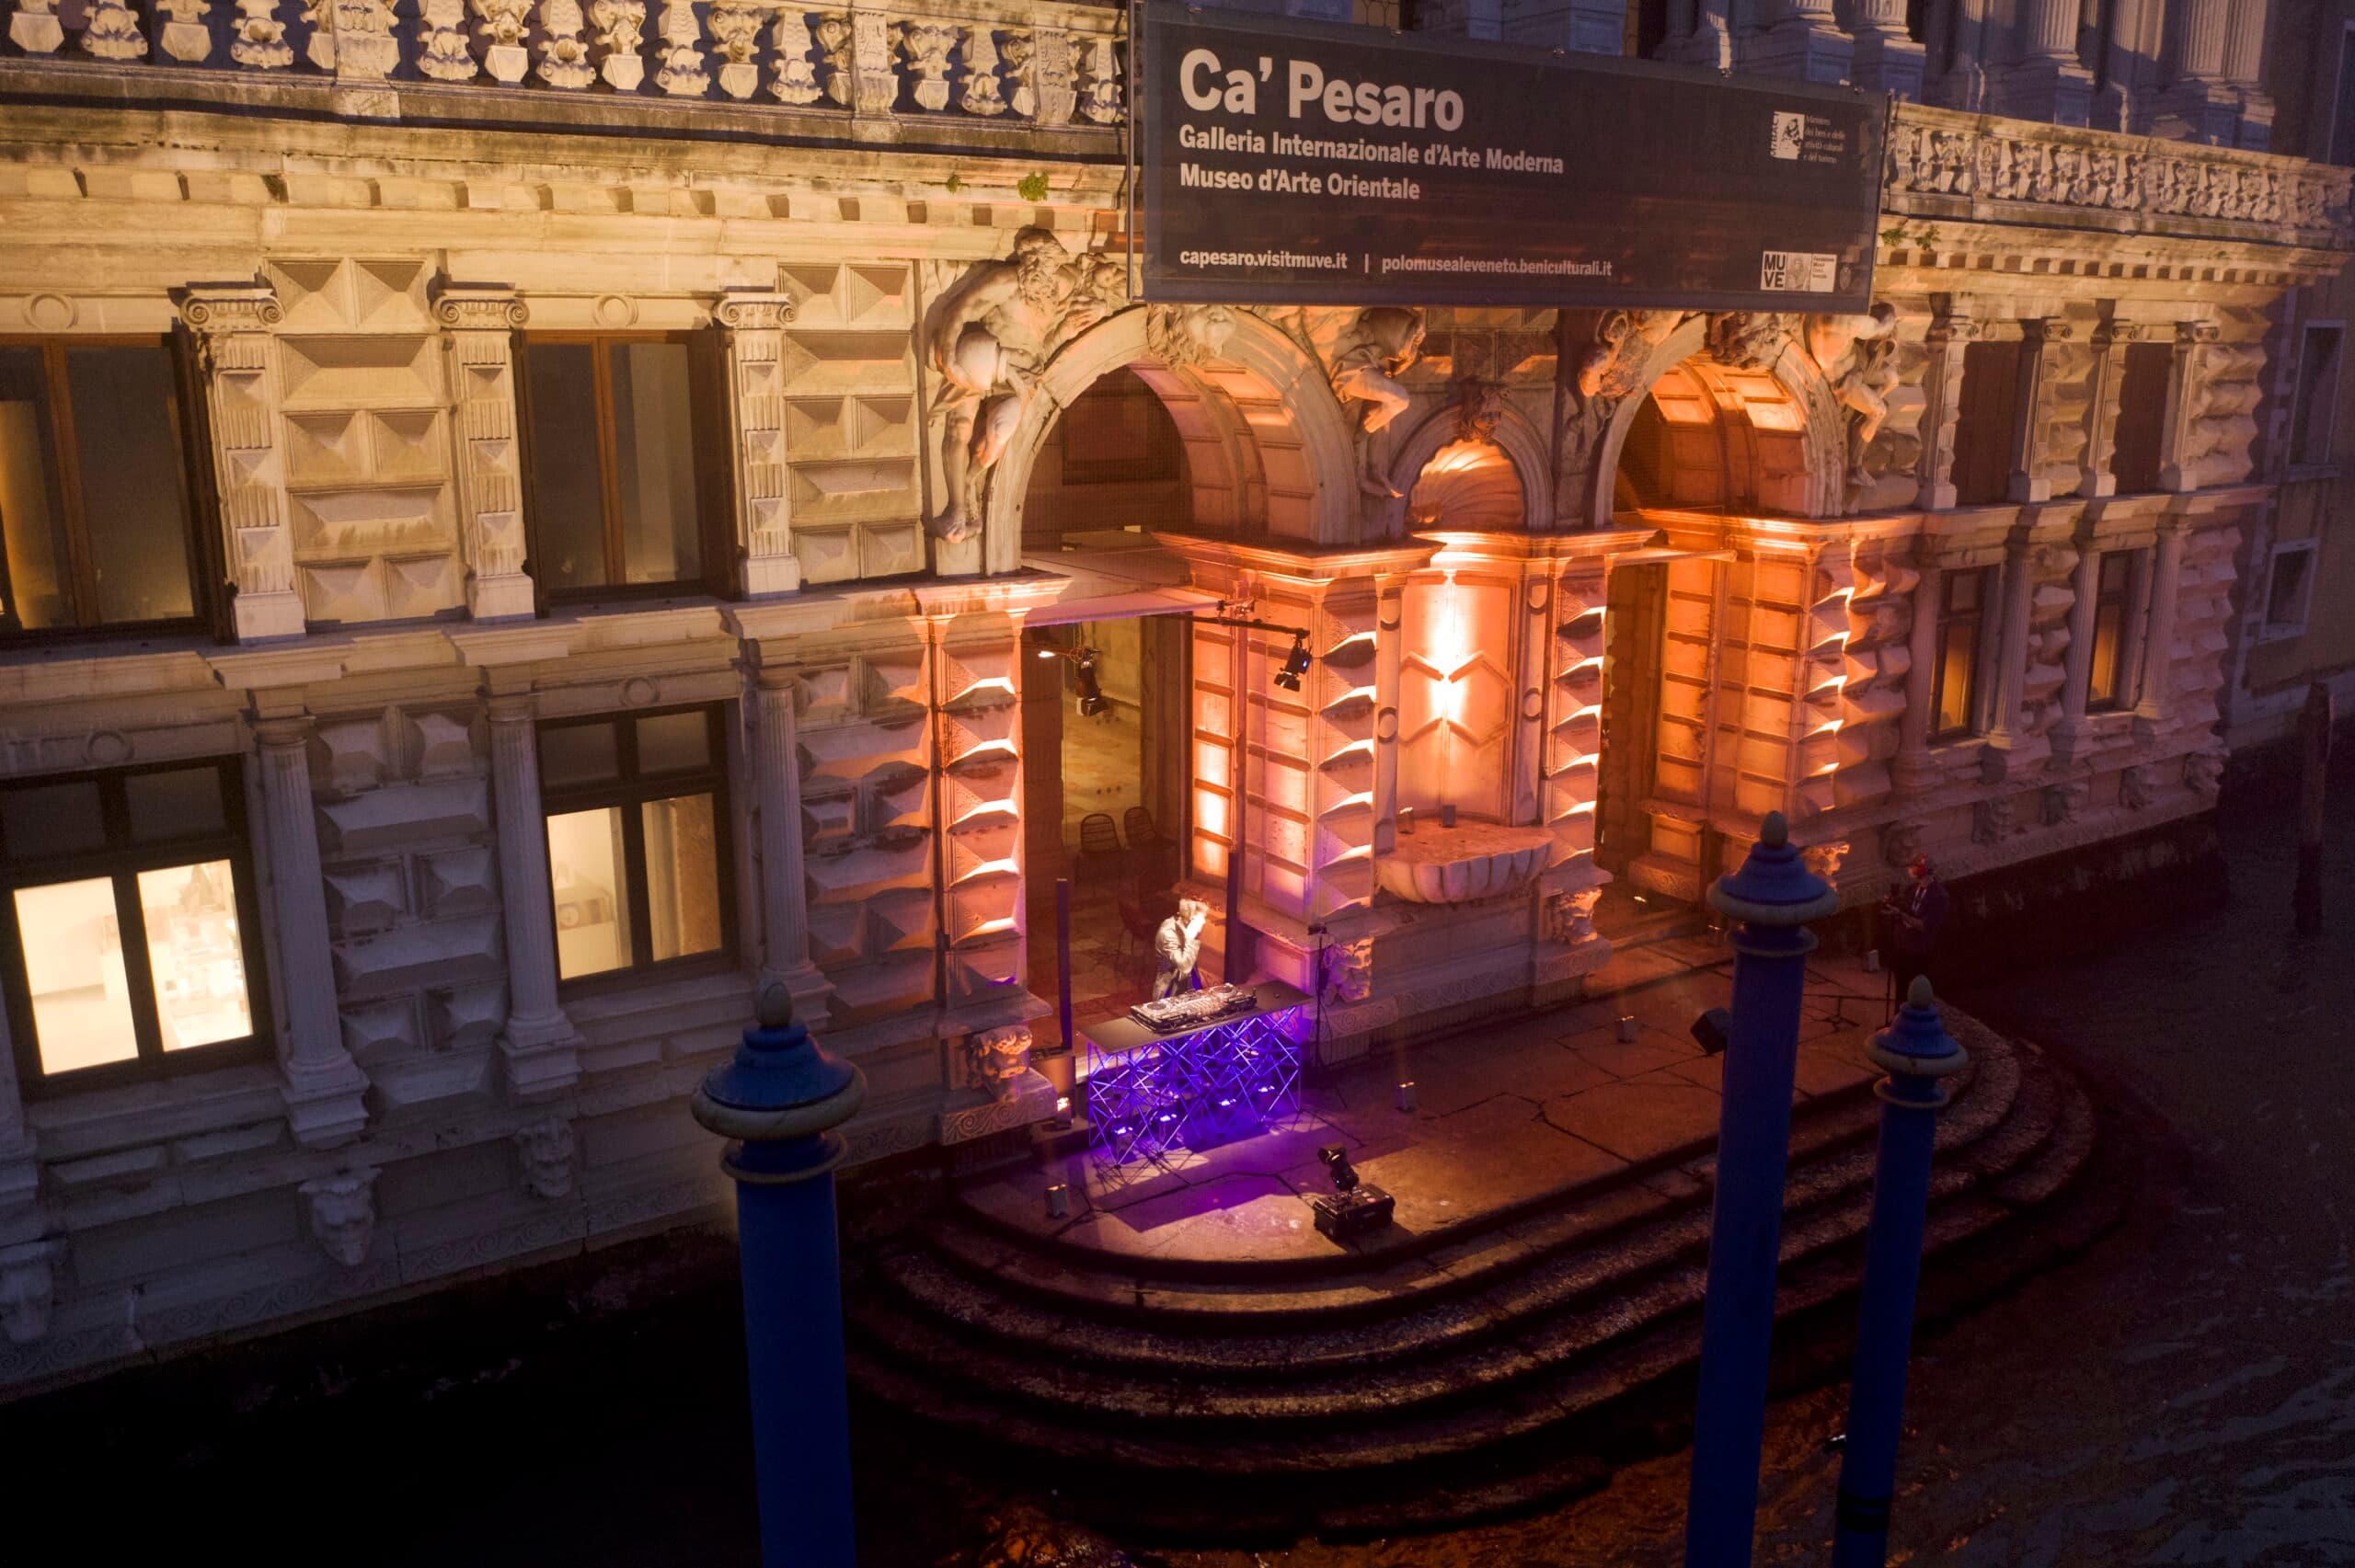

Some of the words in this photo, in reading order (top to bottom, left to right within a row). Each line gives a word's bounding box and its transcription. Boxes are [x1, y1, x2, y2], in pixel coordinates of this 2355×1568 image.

[1179, 48, 1273, 115] Ca'
[1289, 59, 1465, 132] Pesaro
[1179, 123, 1266, 154] Galleria
[1272, 132, 1419, 164] Internazionale
[1424, 143, 1481, 168] d'Arte
[1486, 148, 1564, 174] Moderna
[1179, 162, 1254, 189] Museo
[1258, 168, 1322, 194] d'Arte
[1327, 173, 1421, 200] Orientale
[1179, 249, 1349, 269] capesaro.visitmuve.it
[1382, 254, 1613, 277] polomusealeveneto.beniculturali.it
[1763, 254, 1786, 270] MU
[1763, 271, 1785, 288] VE
